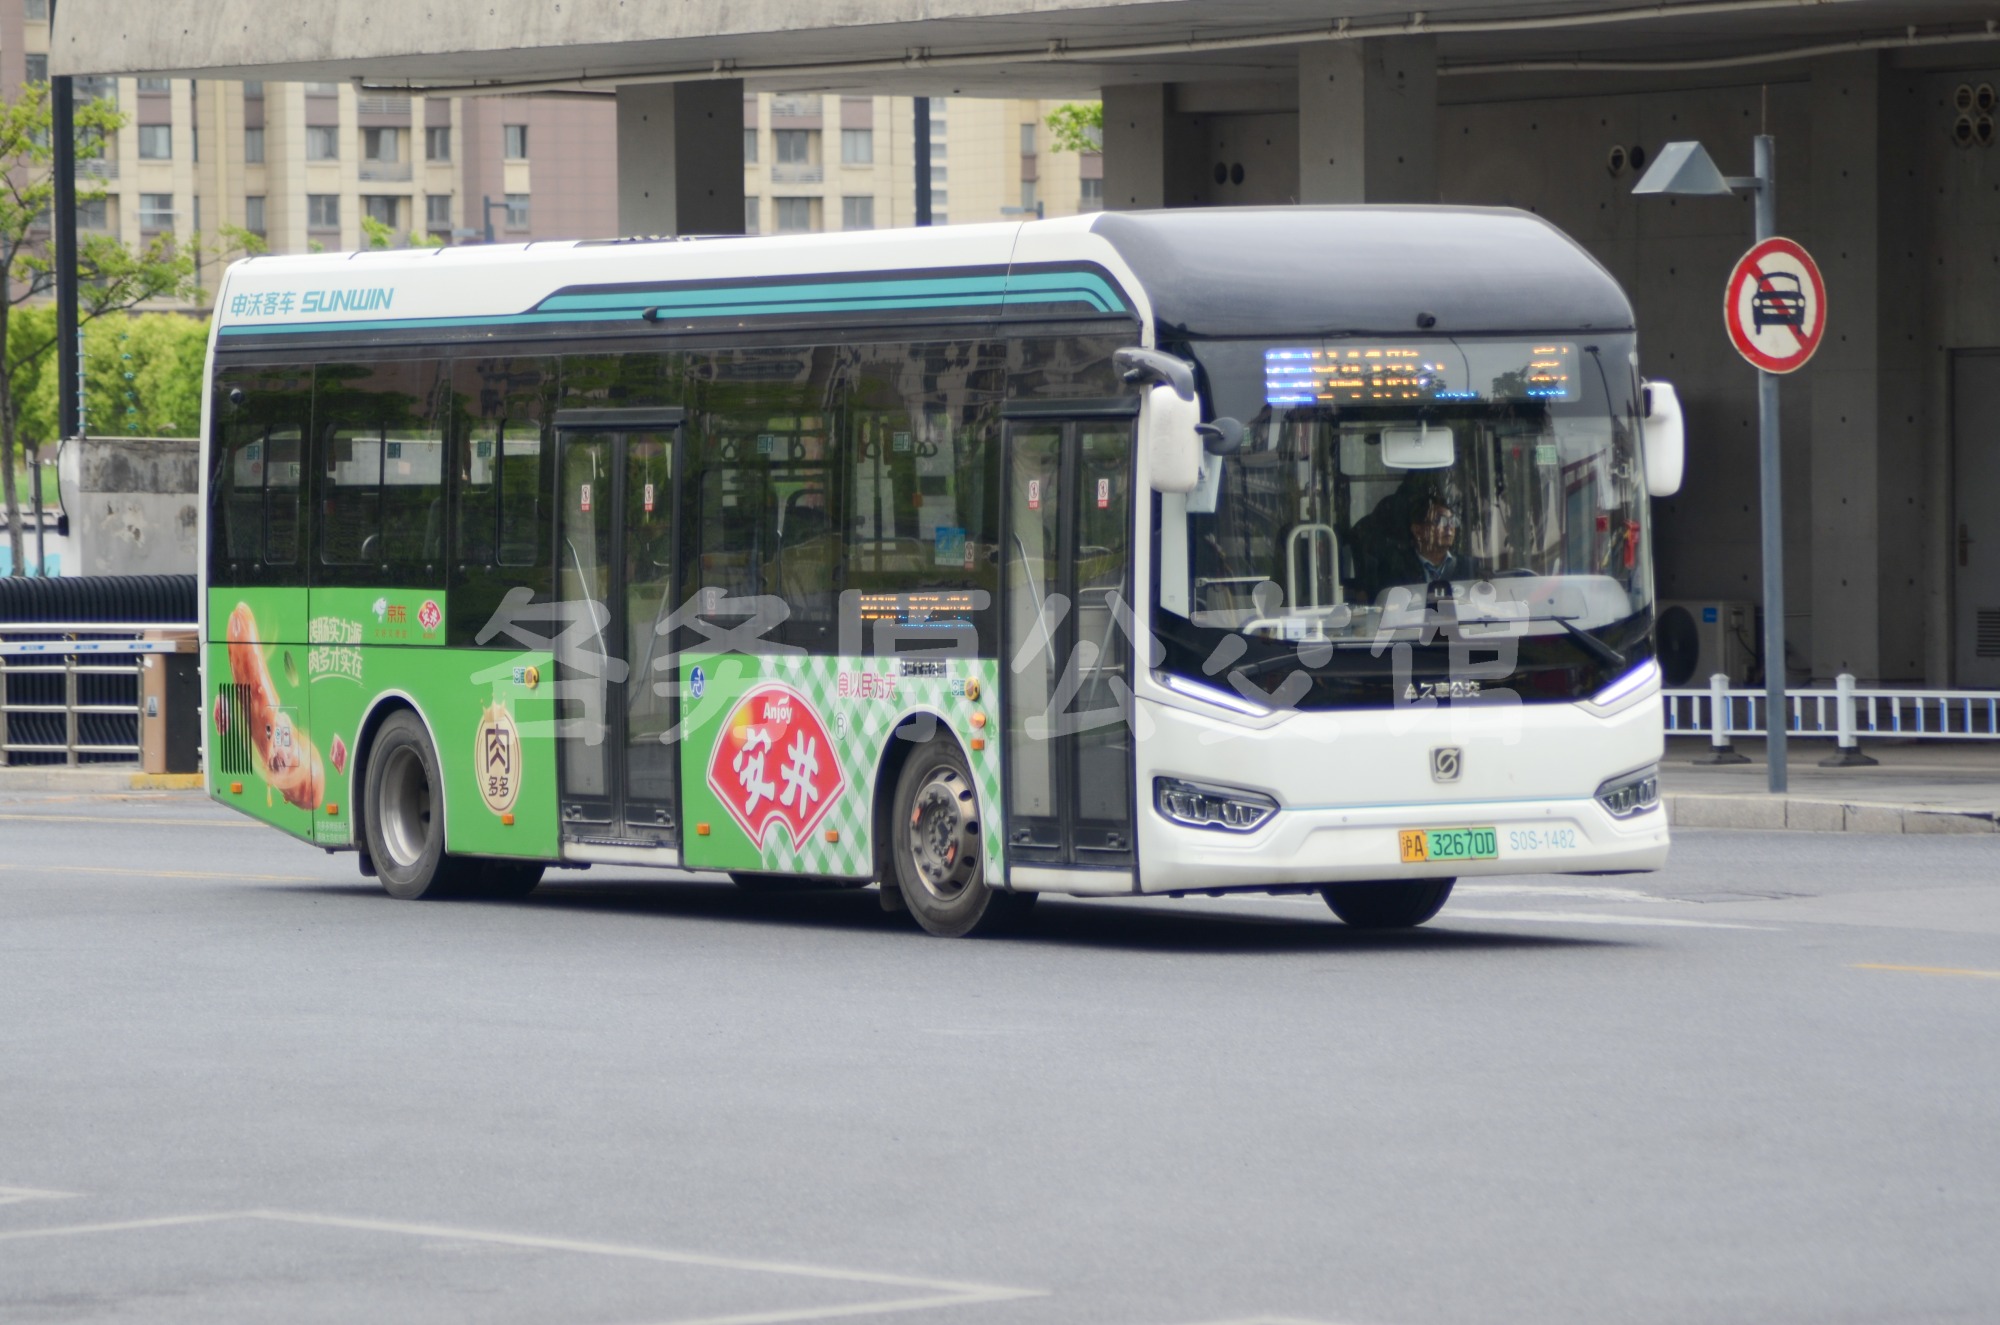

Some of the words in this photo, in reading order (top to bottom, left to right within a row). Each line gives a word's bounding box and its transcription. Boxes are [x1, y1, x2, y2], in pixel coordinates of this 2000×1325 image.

[230, 291, 296, 317] 申沃客车
[300, 288, 395, 313] SUNWIN
[387, 605, 407, 623] 京东
[838, 672, 897, 700] 食以民为天
[763, 695, 792, 724] Anjoy
